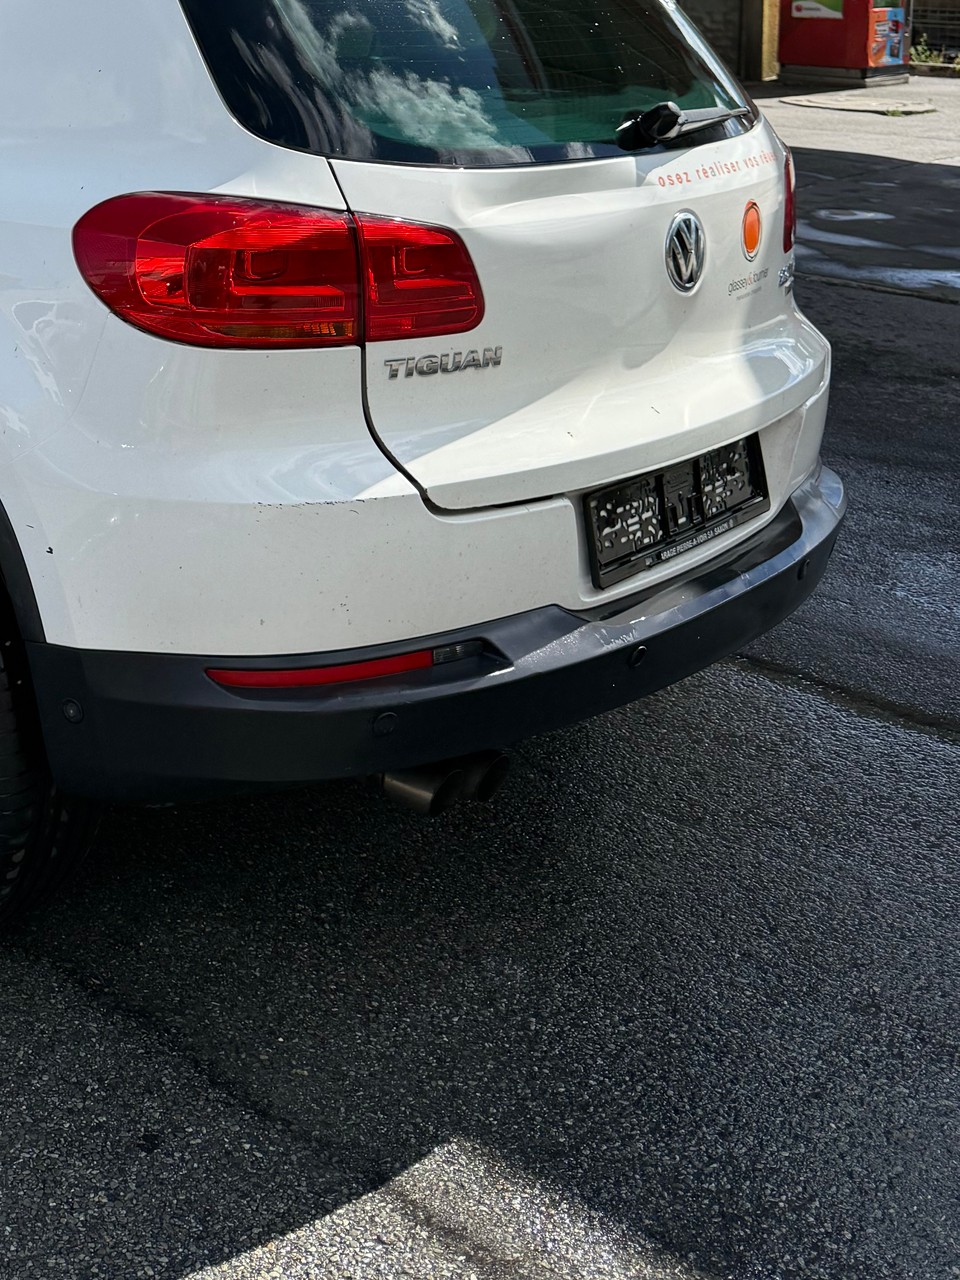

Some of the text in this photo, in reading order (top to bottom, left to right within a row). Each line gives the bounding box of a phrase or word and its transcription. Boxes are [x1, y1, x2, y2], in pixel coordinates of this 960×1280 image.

[658, 172, 691, 187] osez
[696, 160, 741, 180] réaliser
[743, 156, 759, 169] vos
[384, 346, 503, 380] TIGUAN
